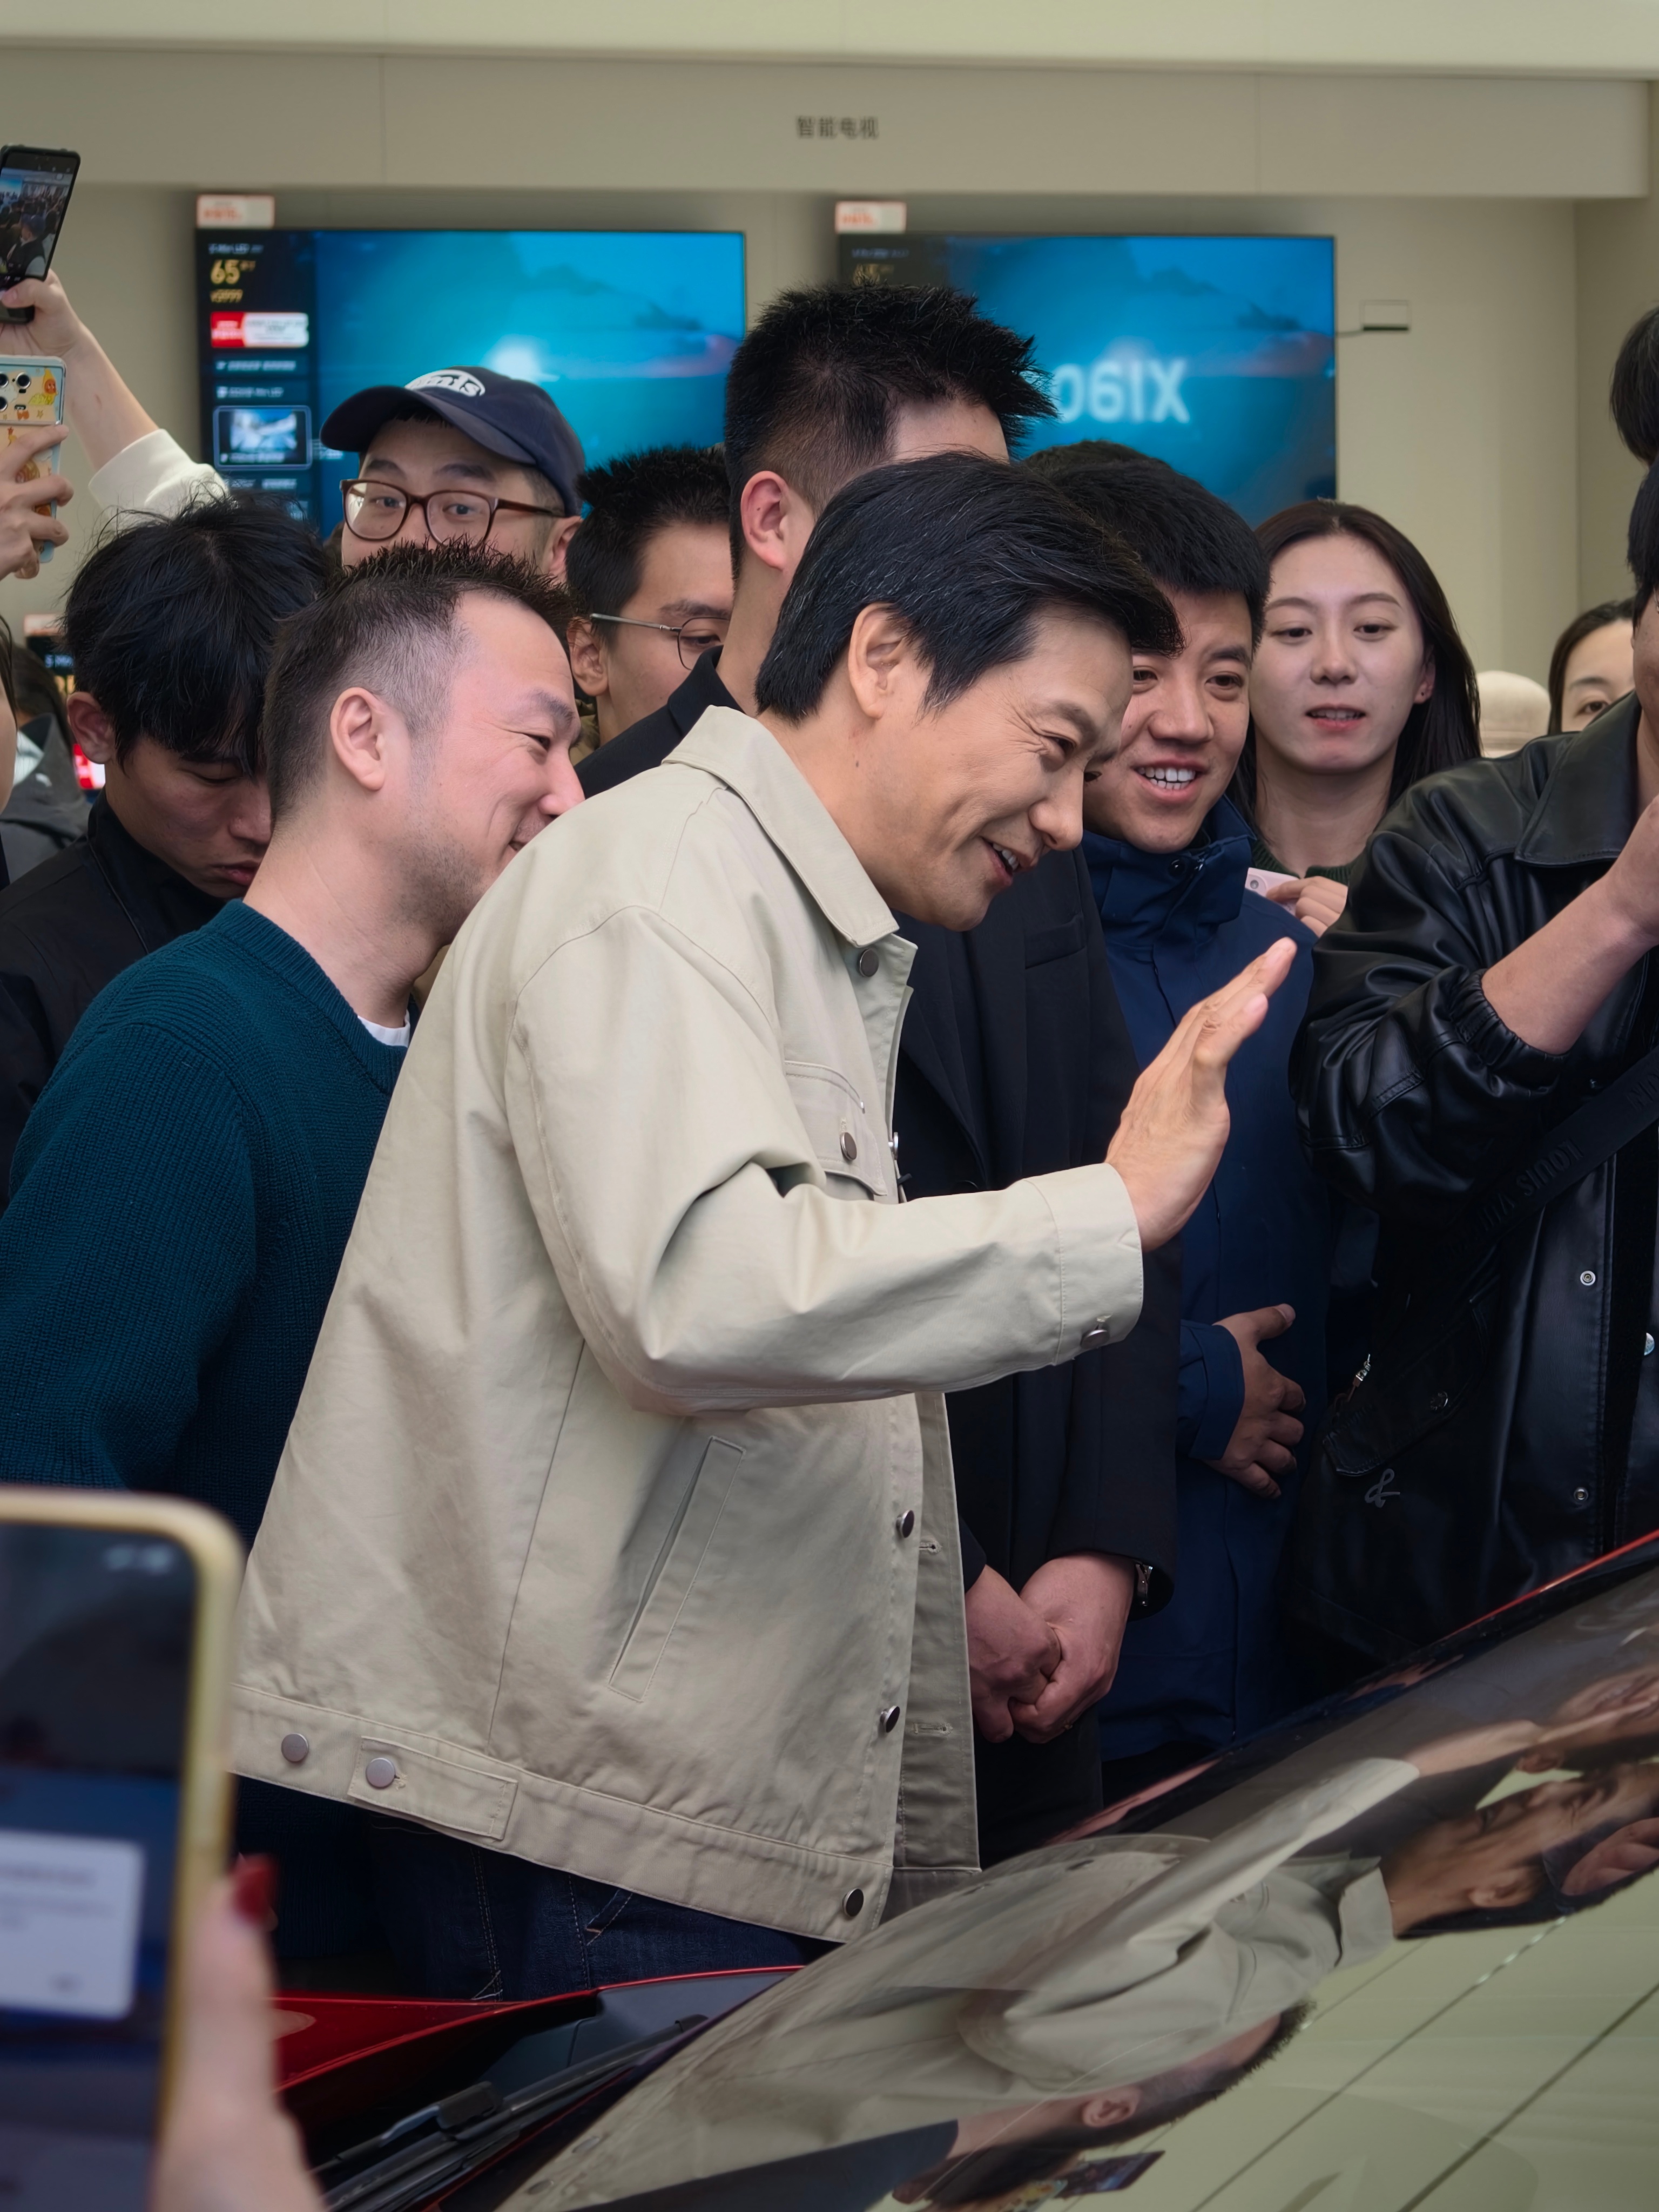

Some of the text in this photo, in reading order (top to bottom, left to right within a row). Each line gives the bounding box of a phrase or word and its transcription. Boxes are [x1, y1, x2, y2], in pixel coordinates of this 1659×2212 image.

[797, 116, 879, 139] 智能电视
[211, 259, 240, 284] 65
[1515, 1137, 1584, 1197] LOUIS
